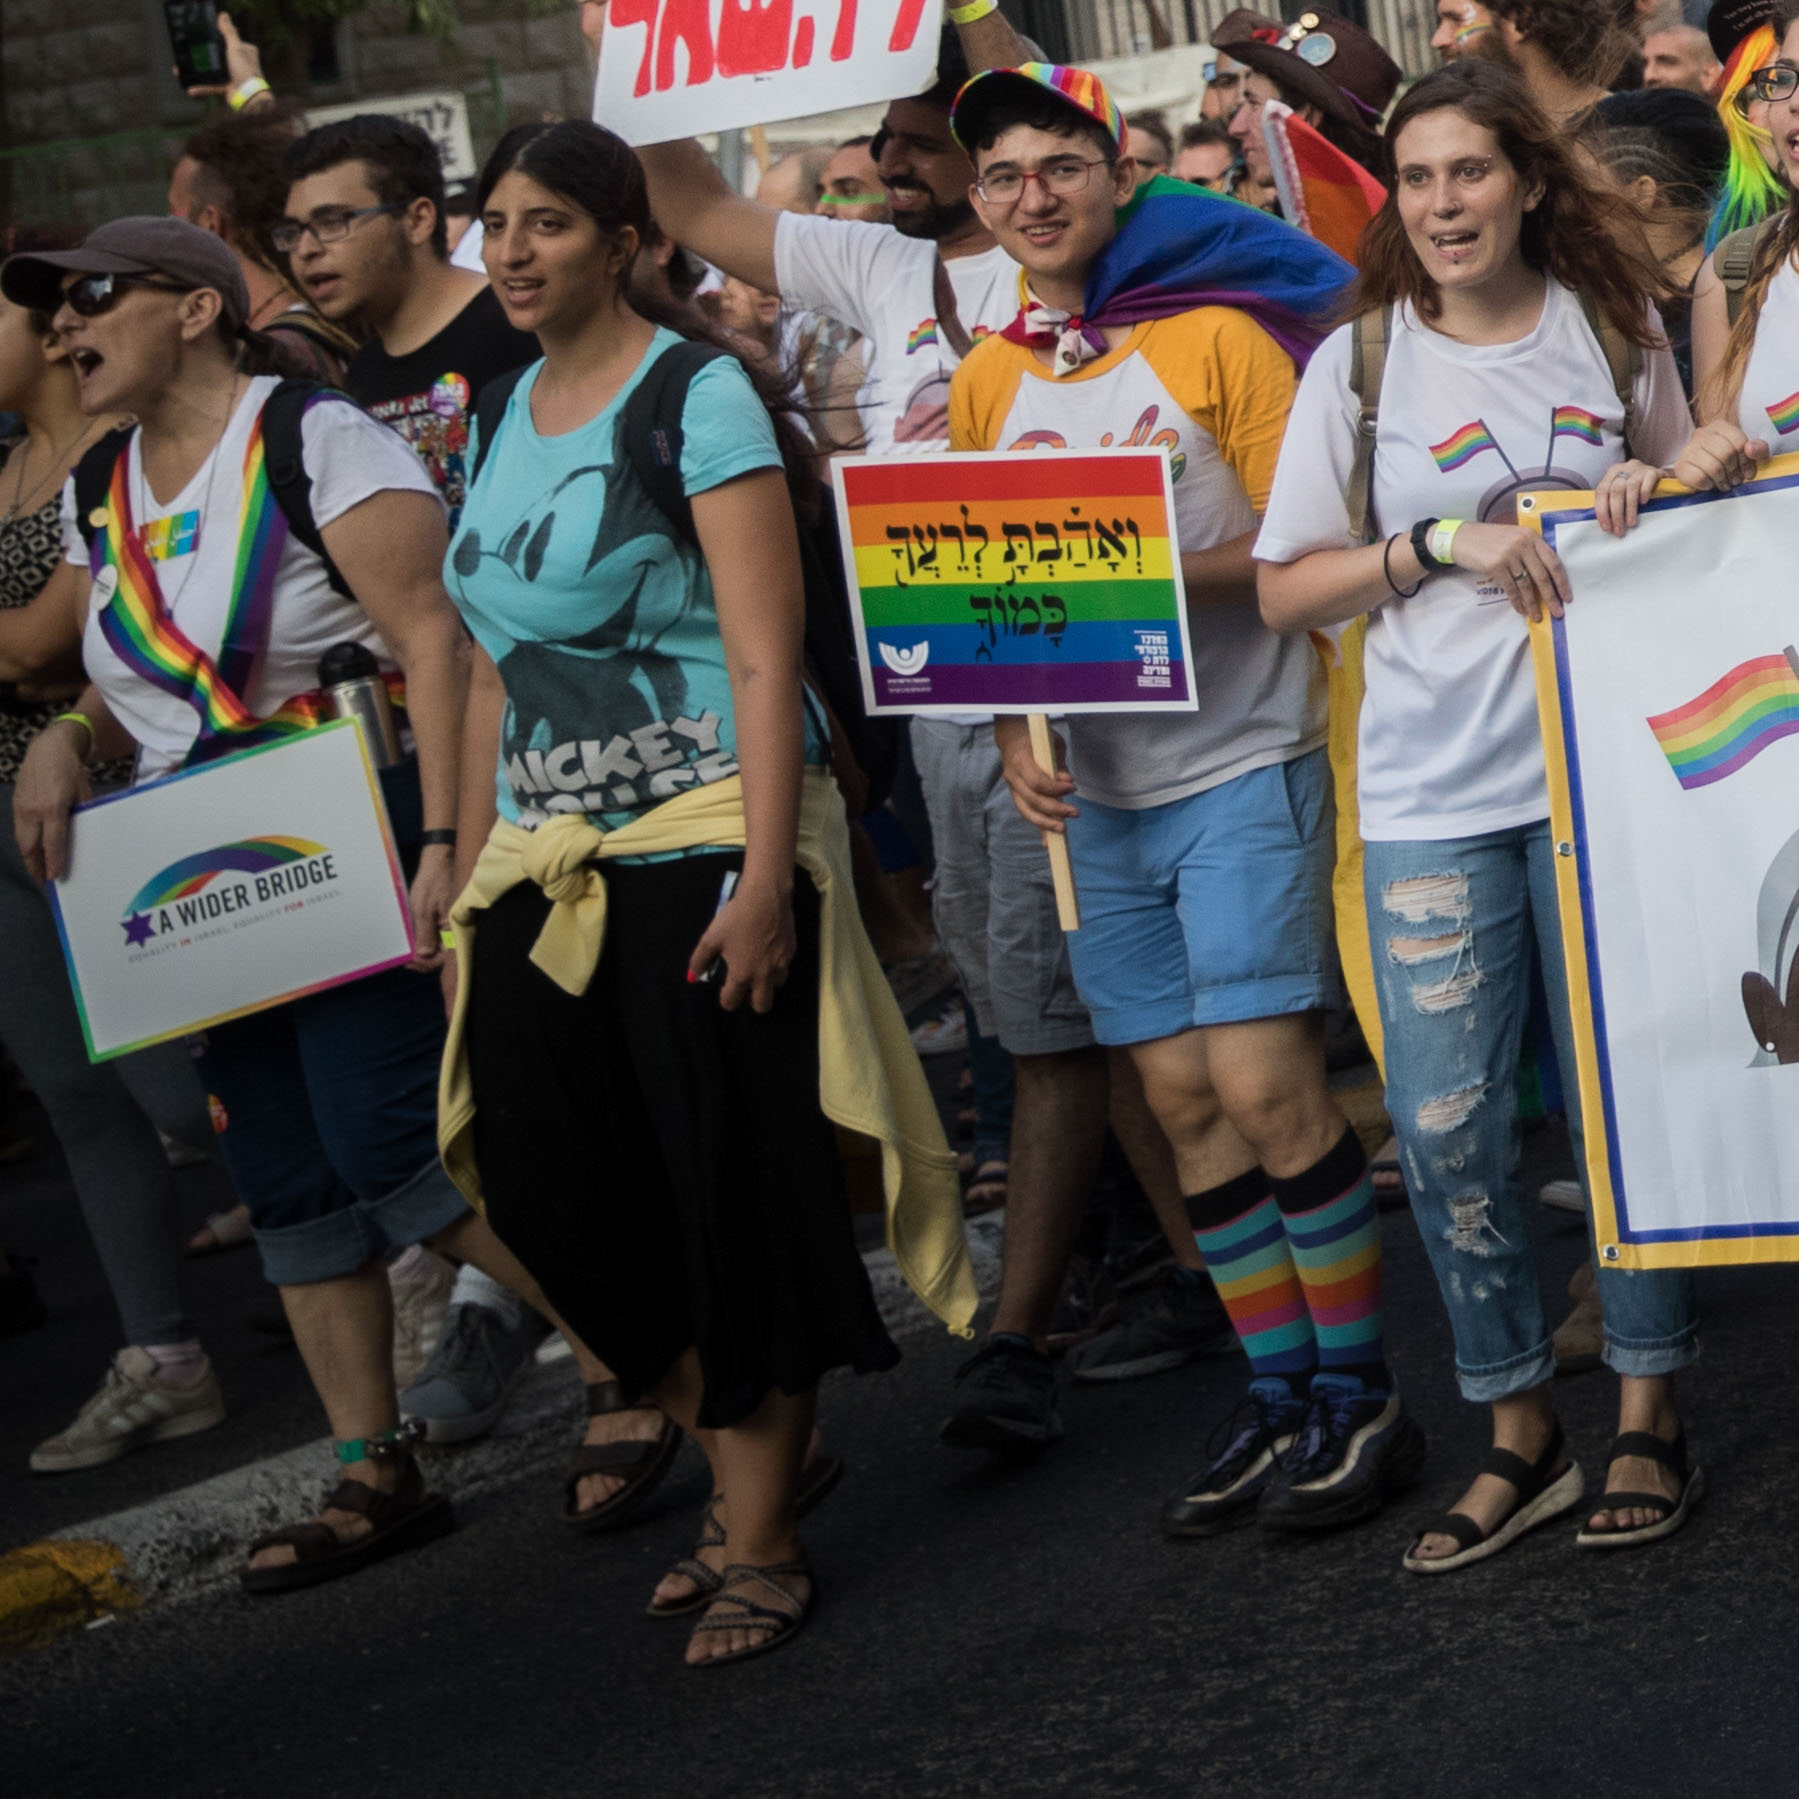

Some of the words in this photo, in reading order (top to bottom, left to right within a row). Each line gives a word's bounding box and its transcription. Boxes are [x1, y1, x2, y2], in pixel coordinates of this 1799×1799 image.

[506, 710, 722, 795] MICKEY
[158, 909, 175, 934] A
[176, 883, 252, 928] WIDER
[253, 854, 339, 902] BRIDGE
